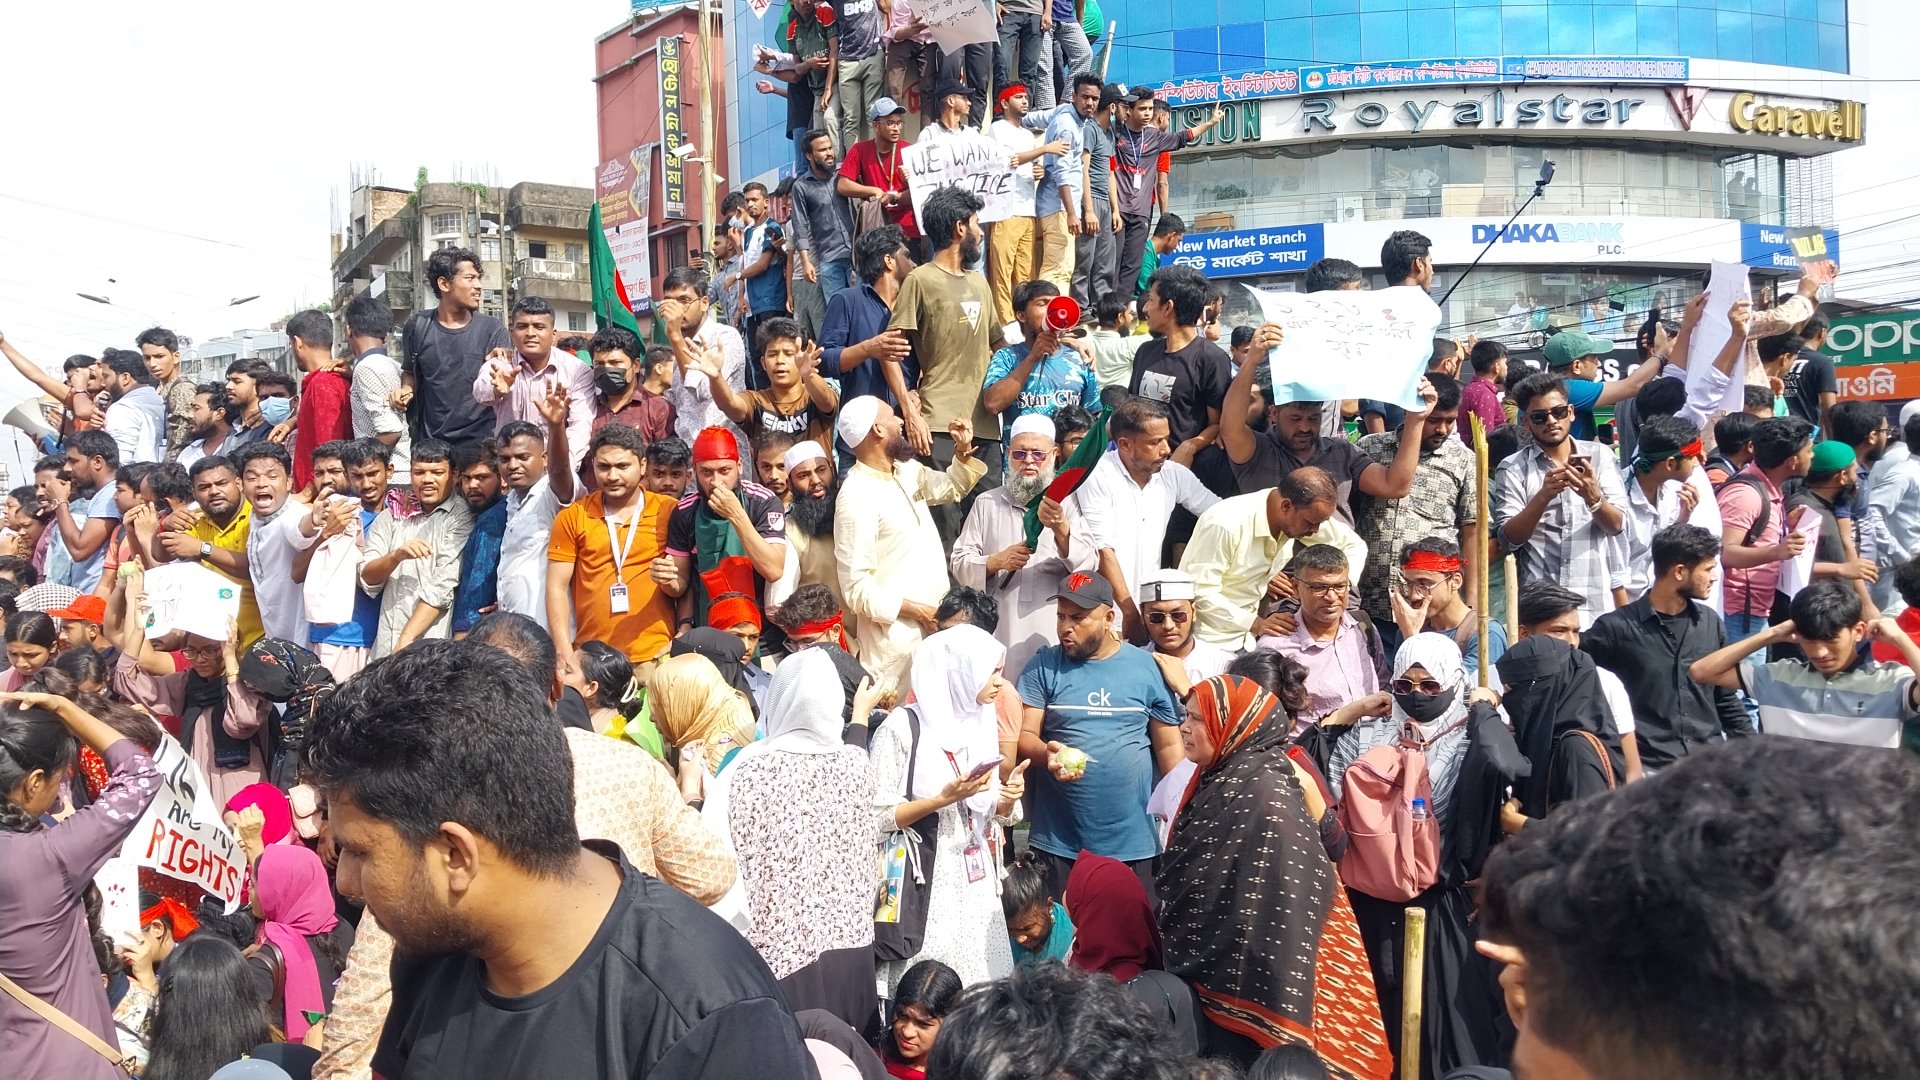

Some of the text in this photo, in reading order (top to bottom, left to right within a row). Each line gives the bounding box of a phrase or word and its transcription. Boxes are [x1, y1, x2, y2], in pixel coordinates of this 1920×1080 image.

[1222, 70, 1298, 100] ইনস্টিটিউট
[1354, 66, 1370, 84] সিটি
[1303, 89, 1645, 133] Royalstar
[1728, 92, 1863, 141] Caravell
[911, 142, 1000, 176] WE WAN
[917, 171, 1013, 196] TICE
[1173, 230, 1307, 253] New Market Branch
[1760, 229, 1784, 244] New
[1211, 251, 1265, 269] মার্কেট
[1269, 250, 1307, 263] শাখা
[1597, 245, 1625, 255] PLC.
[1773, 253, 1798, 266] Bran
[1017, 392, 1050, 408] Star
[1087, 687, 1112, 707] ck
